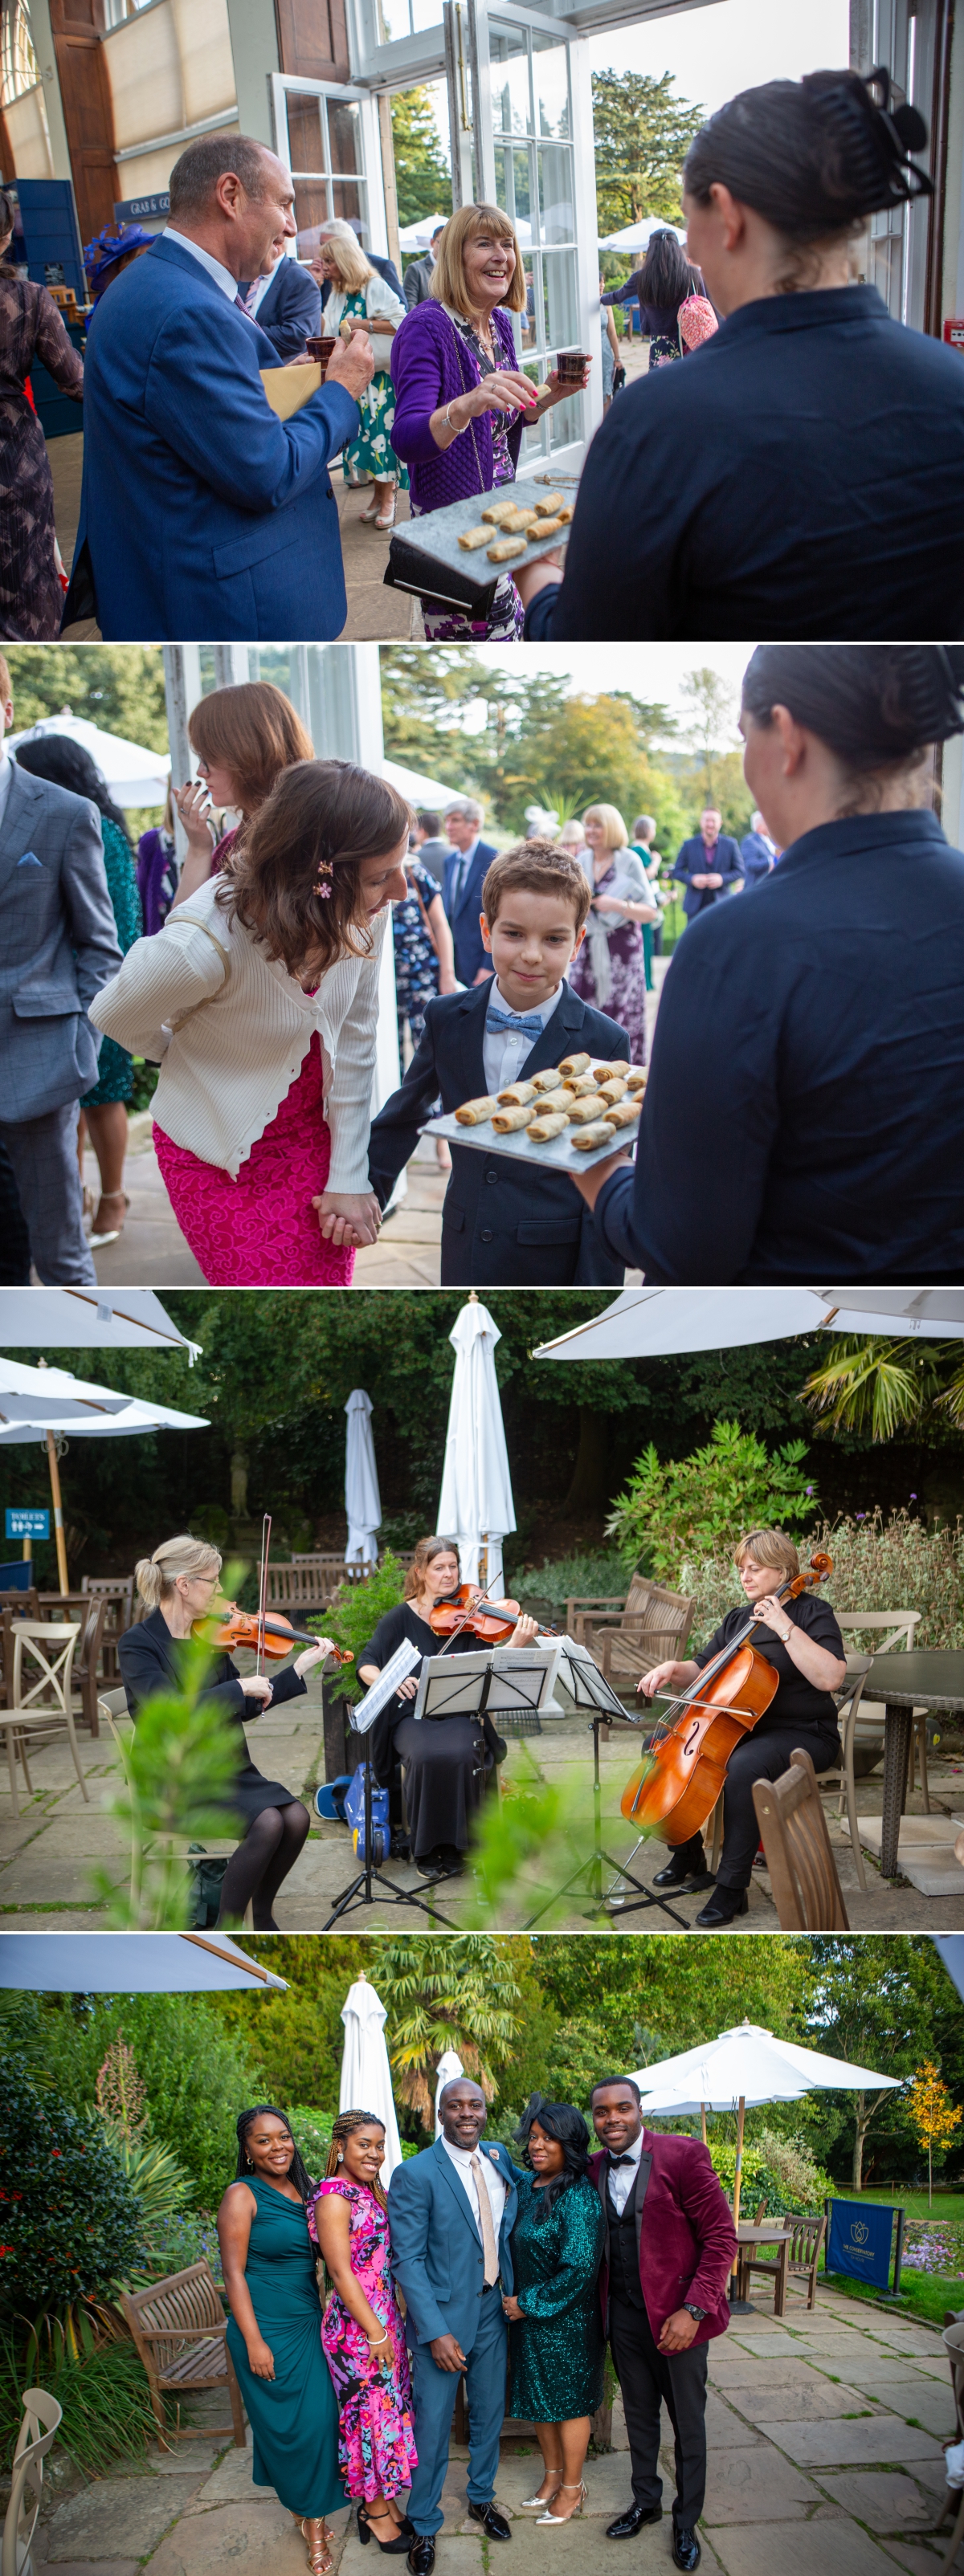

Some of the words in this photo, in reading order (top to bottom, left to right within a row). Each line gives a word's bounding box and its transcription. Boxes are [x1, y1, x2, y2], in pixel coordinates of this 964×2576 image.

[130, 201, 150, 214] GRAB
[150, 198, 157, 211] &
[10, 1512, 46, 1521] TOILETS
